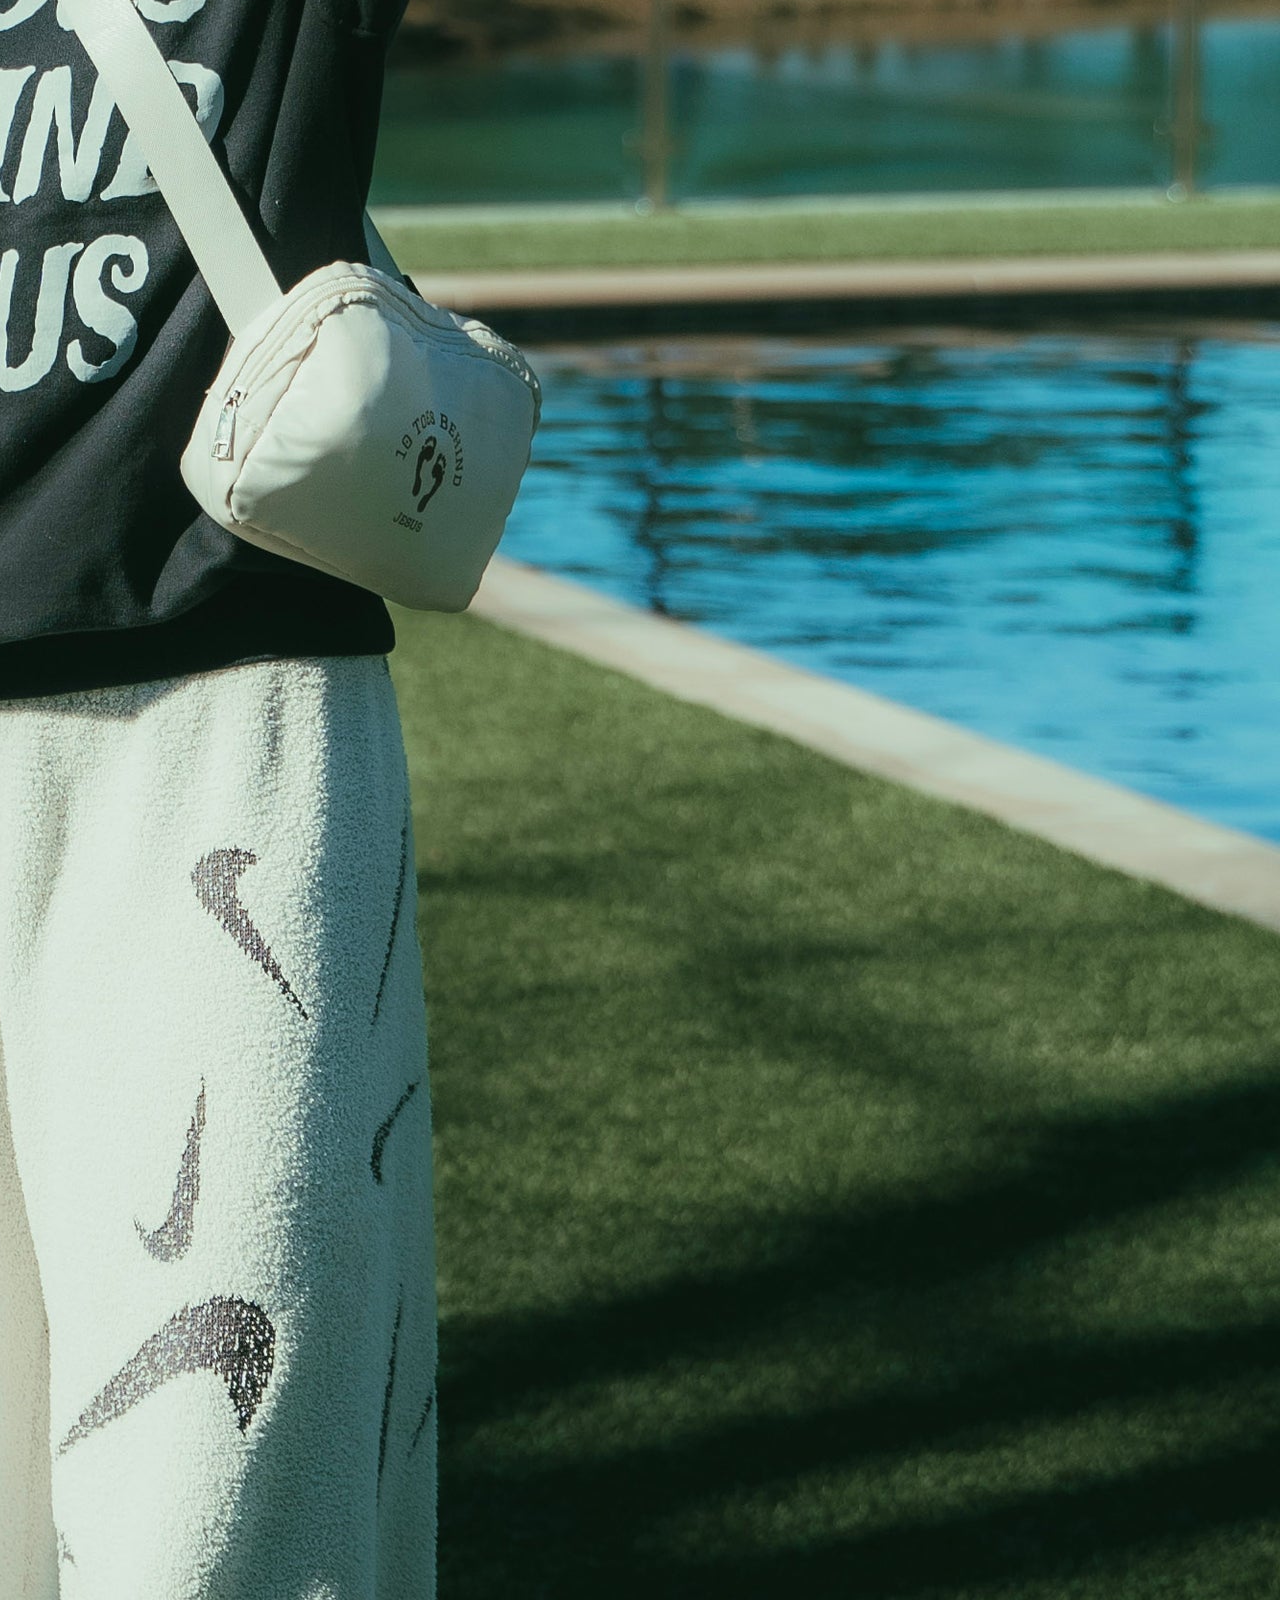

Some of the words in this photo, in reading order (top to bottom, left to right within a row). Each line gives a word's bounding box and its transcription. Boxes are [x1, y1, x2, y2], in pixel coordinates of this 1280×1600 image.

[395, 433, 414, 461] 10
[411, 409, 436, 436] TOES
[439, 412, 464, 487] BEHIND
[392, 511, 424, 533] JESUS
